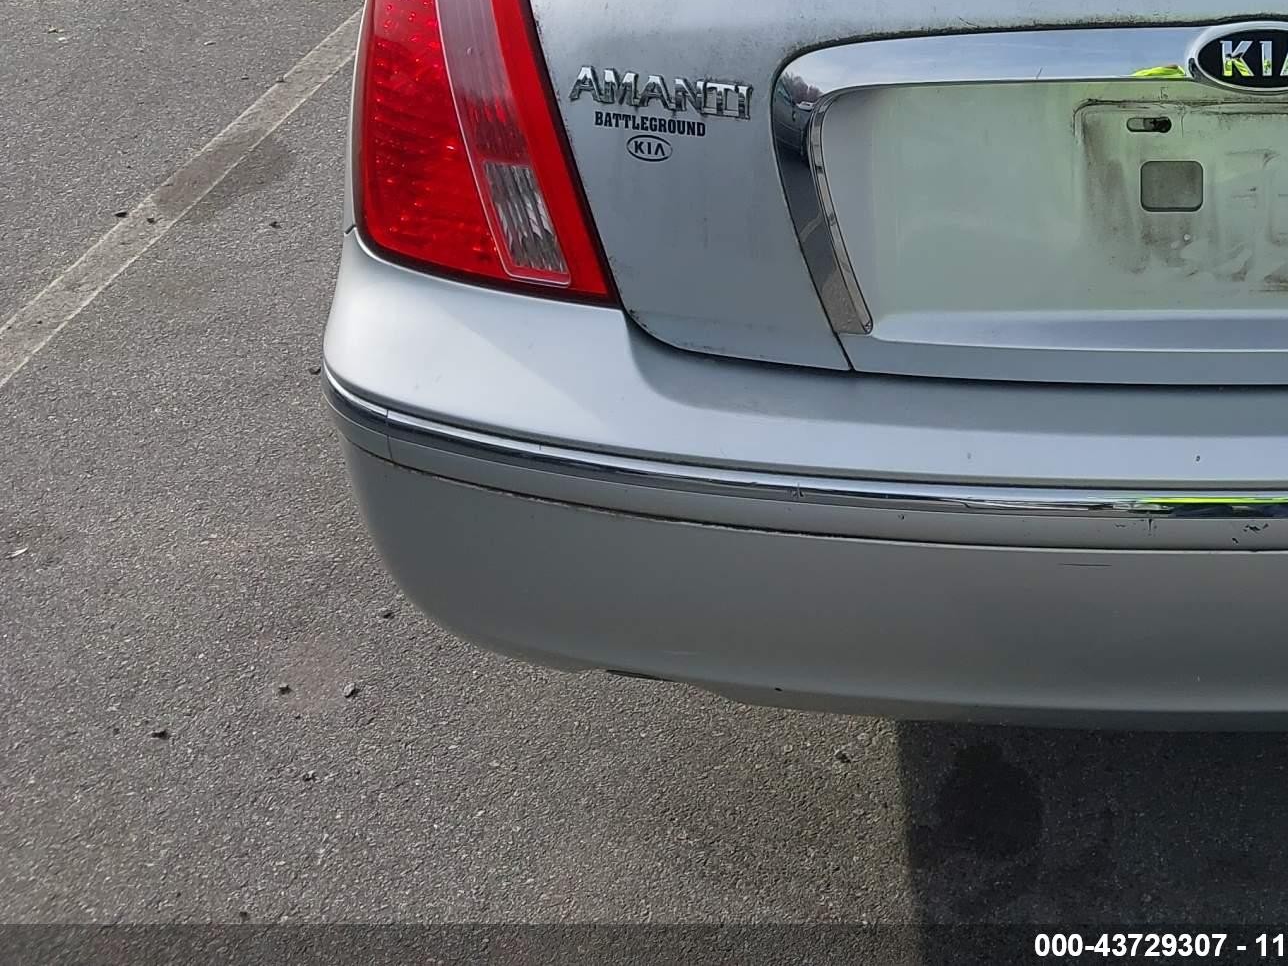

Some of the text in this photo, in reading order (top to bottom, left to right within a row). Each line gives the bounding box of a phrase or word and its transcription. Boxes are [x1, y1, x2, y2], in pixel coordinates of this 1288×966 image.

[569, 65, 754, 120] AMANTI
[594, 110, 707, 137] BATTLEGROUND
[633, 139, 666, 157] KIA
